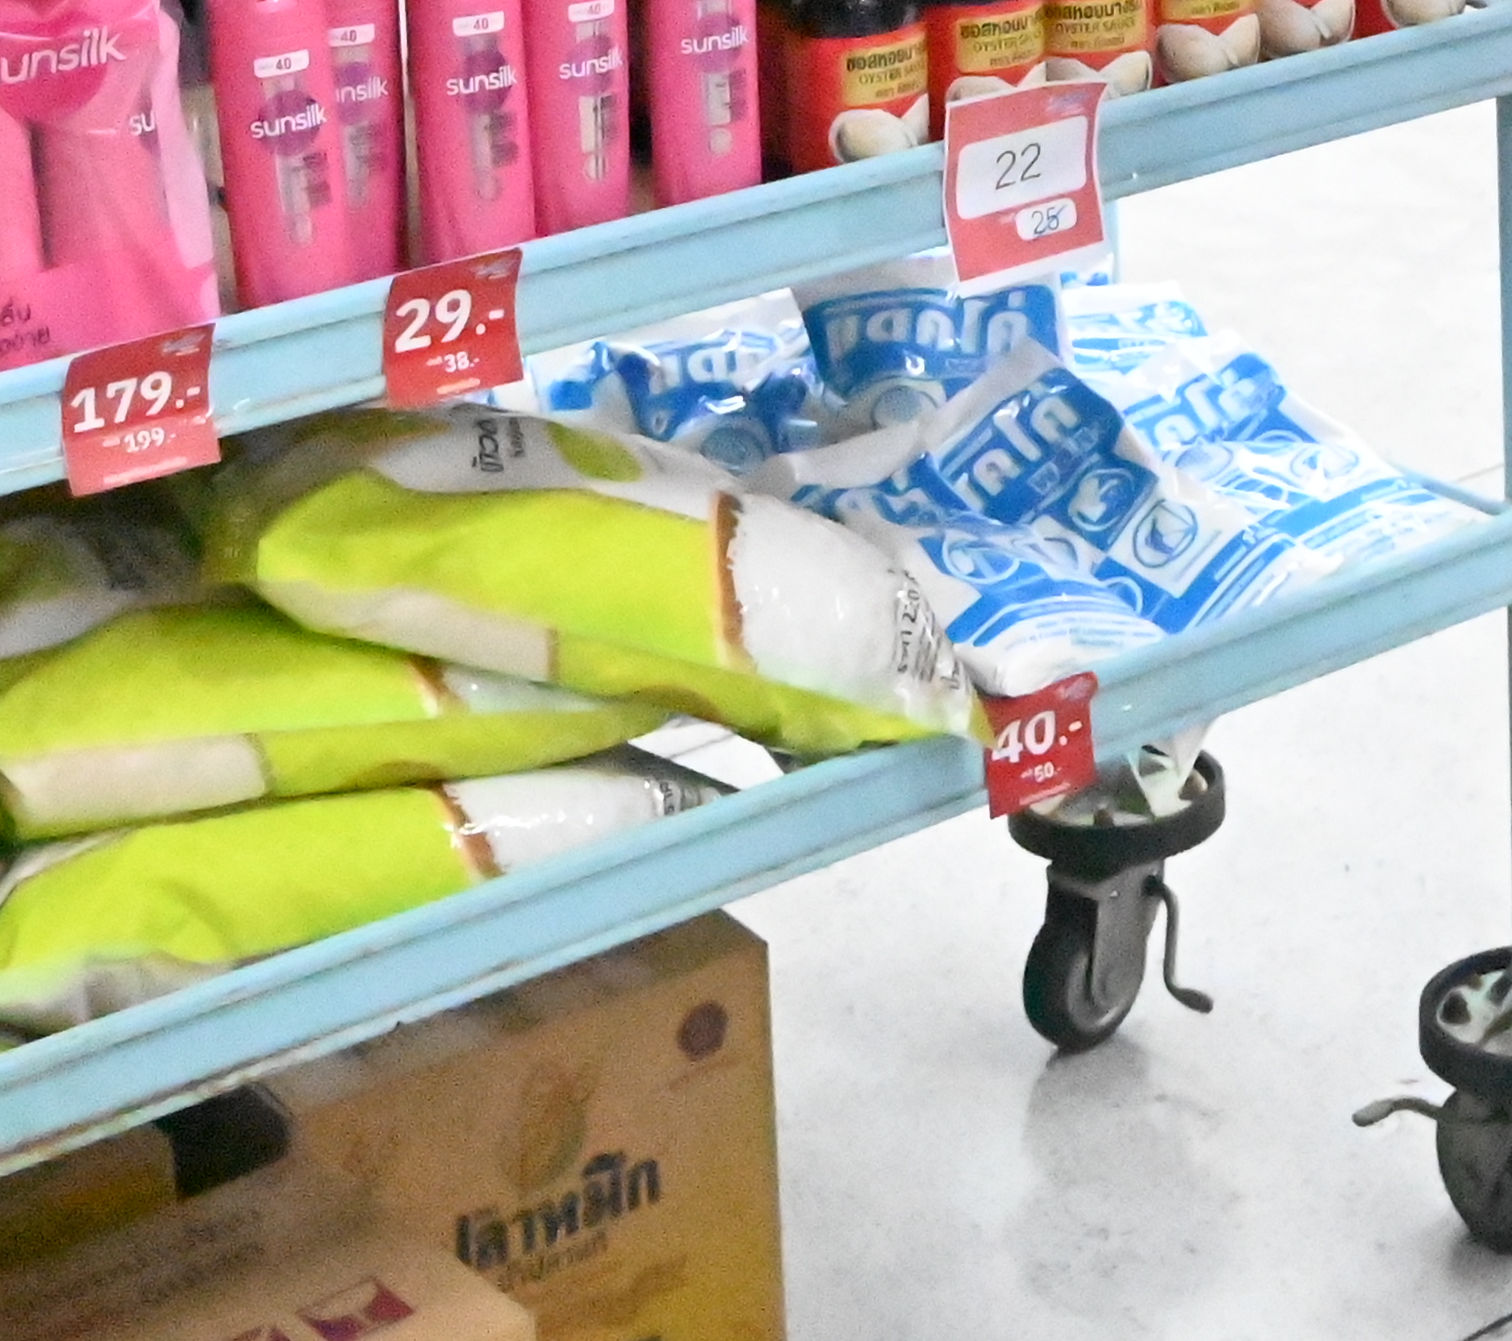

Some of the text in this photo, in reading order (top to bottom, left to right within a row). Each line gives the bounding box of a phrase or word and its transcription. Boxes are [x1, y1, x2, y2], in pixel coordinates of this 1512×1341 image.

[680, 25, 749, 55] sunsilk
[558, 44, 624, 80] sunsilk
[334, 74, 389, 103] nsilk
[445, 64, 518, 96] sunsilk
[249, 103, 328, 140] sunsilk
[995, 142, 1042, 191] 22
